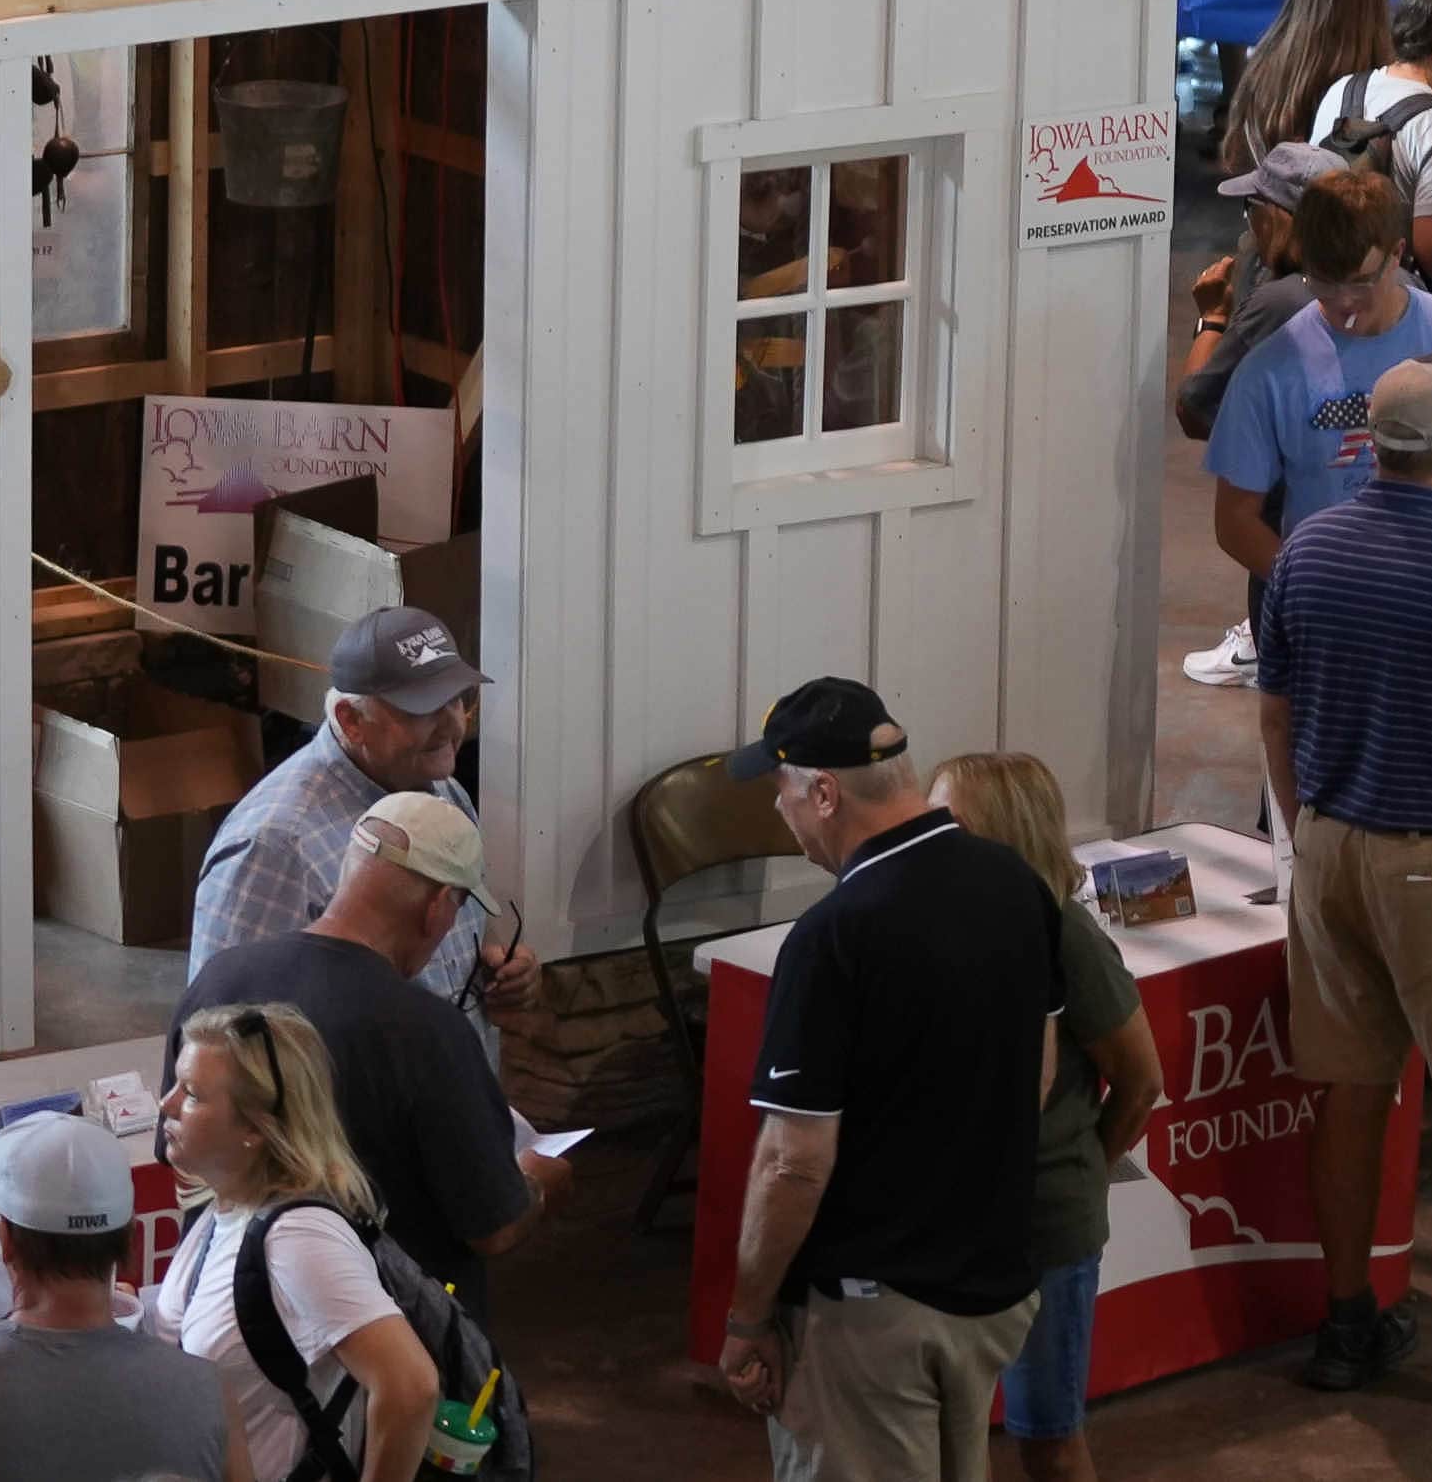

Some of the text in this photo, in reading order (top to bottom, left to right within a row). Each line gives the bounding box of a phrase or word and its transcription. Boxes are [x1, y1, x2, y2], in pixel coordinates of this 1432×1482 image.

[1030, 111, 1169, 154] IOWA BARN
[1095, 145, 1167, 165] FOUNDATION
[1027, 211, 1166, 240] PRESERVATION AWARD
[272, 415, 391, 454] BARN
[152, 545, 251, 607] Bar
[68, 1214, 109, 1229] IOWA
